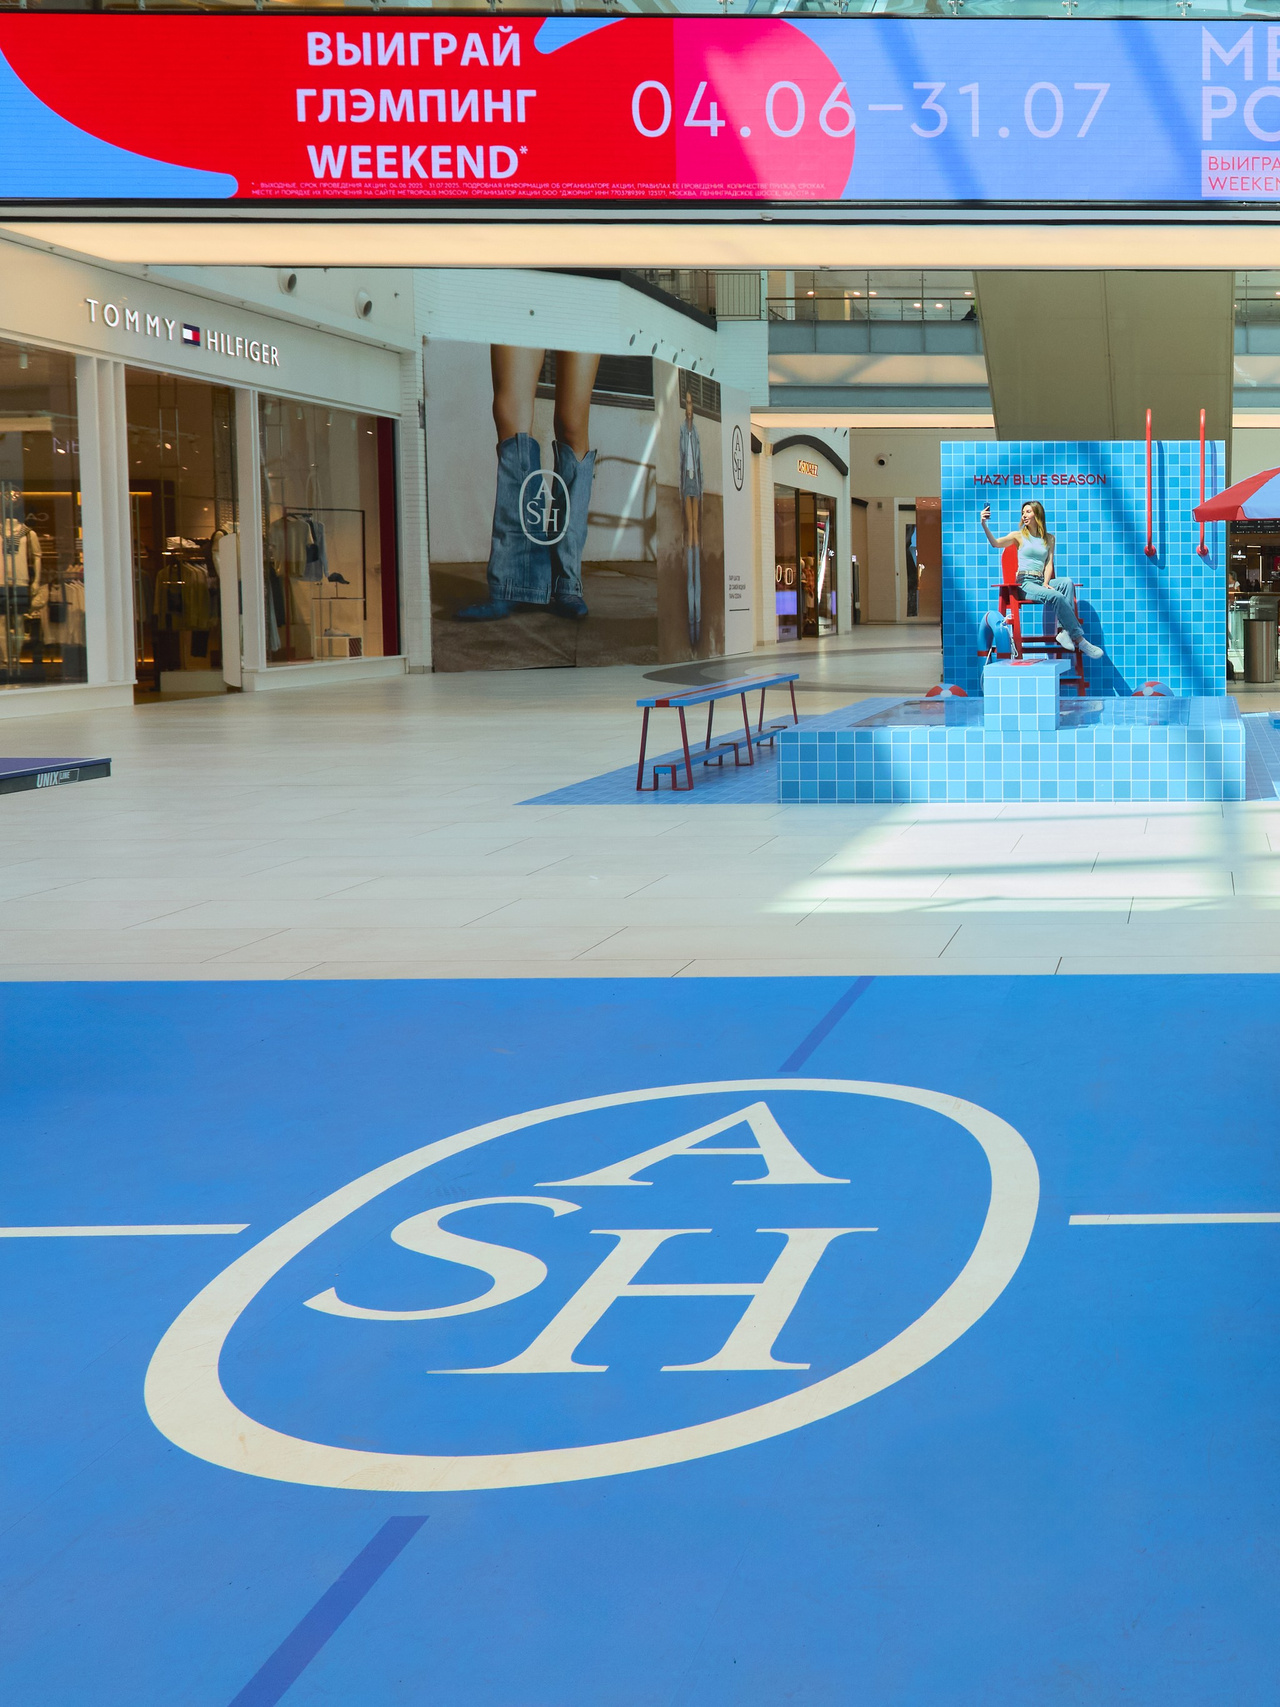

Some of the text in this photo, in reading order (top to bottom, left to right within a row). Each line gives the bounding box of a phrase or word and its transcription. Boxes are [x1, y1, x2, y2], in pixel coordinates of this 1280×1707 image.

[307, 26, 520, 66] ВЫИГРАЙ
[296, 88, 536, 123] ГЛЭМПИНГ
[86, 298, 280, 367] TOMMY HILFIGER
[973, 474, 1106, 485] HAZY BLUE SEASON
[36, 771, 59, 788] UNIX
